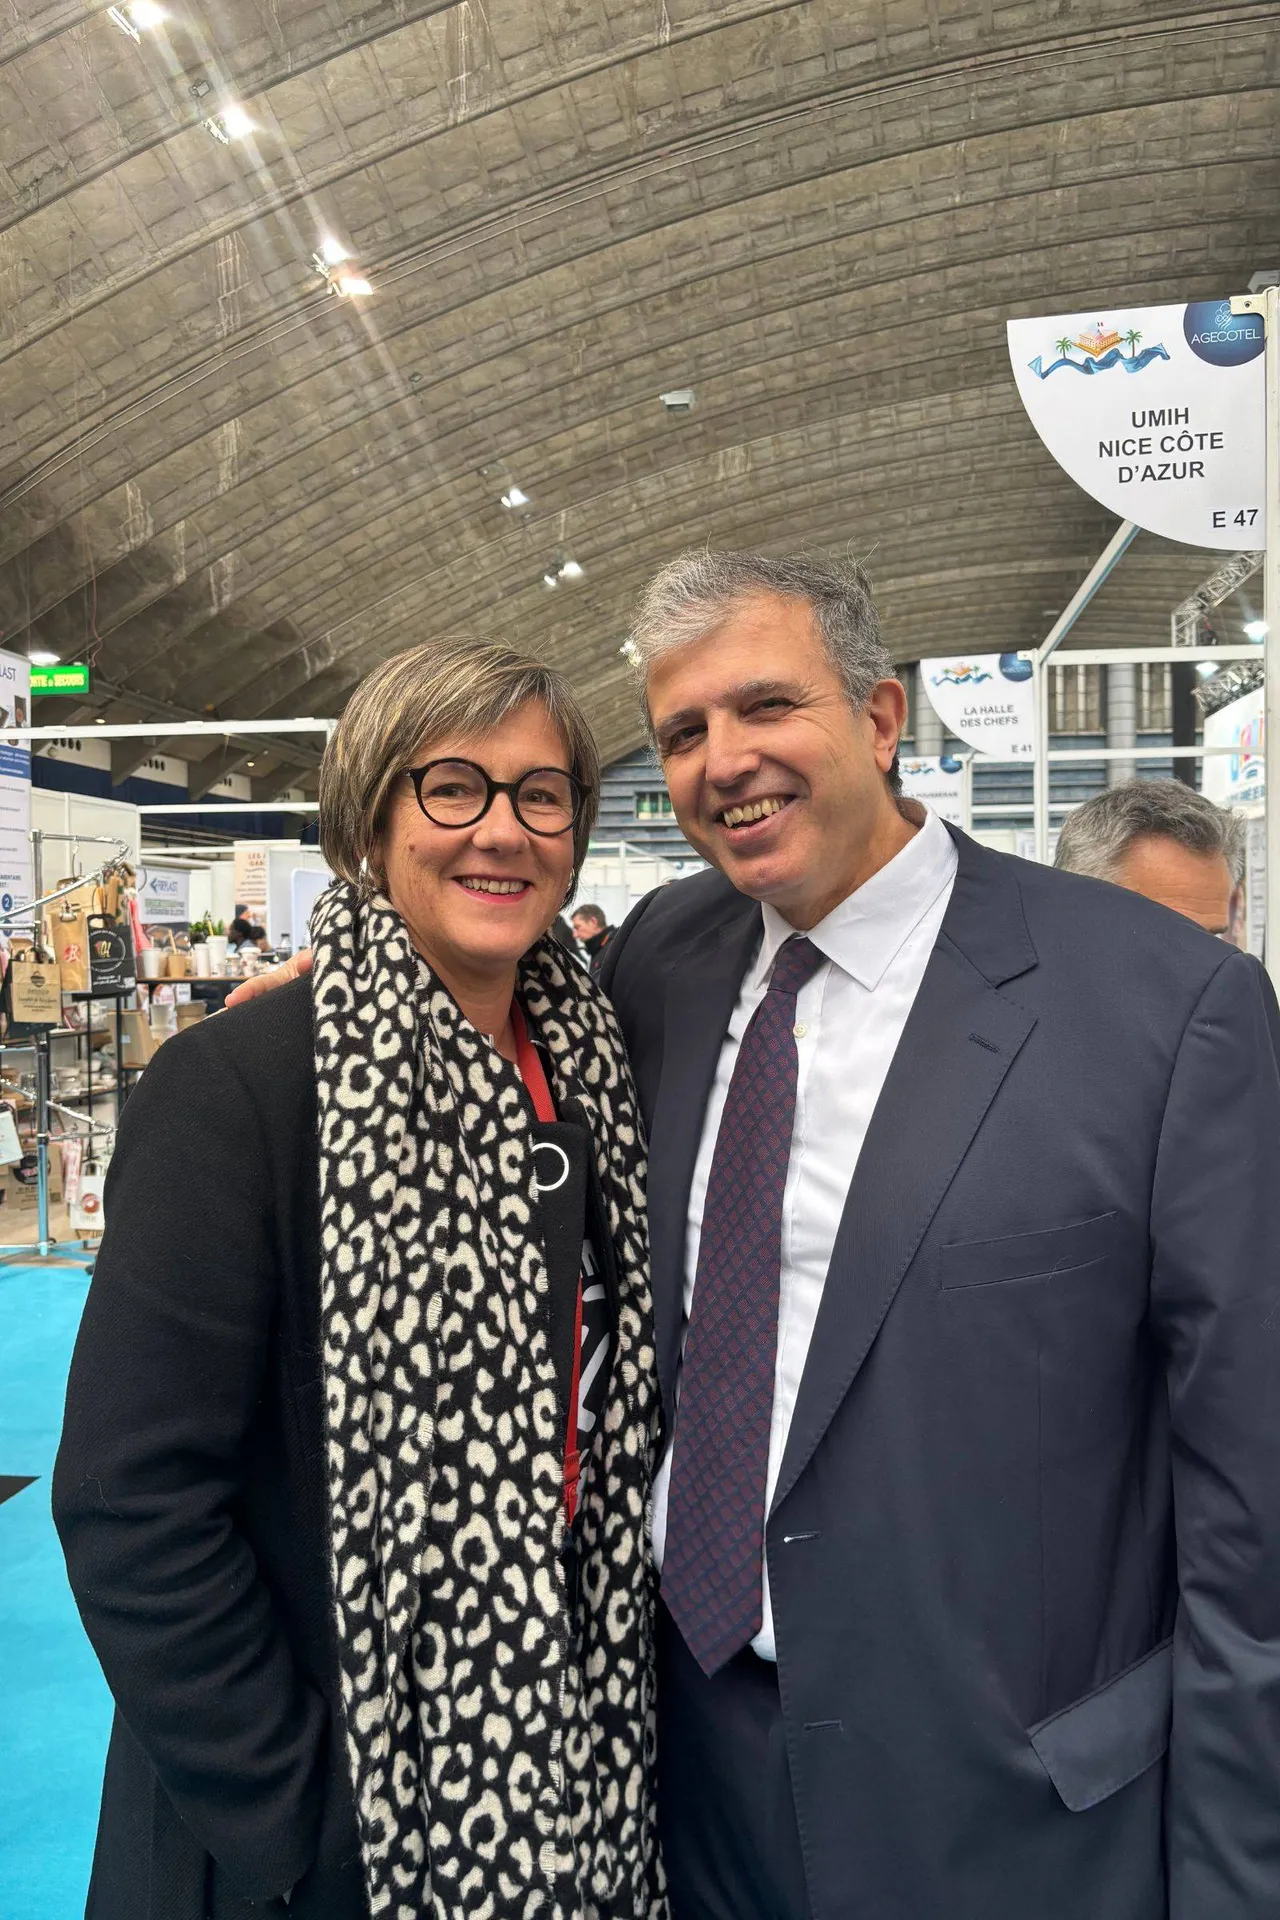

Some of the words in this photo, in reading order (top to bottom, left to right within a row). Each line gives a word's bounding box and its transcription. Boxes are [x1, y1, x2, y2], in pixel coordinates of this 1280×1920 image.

[1191, 328, 1261, 345] AGECOTEL
[1131, 407, 1190, 429] UMIH
[1099, 437, 1152, 458] NICE
[1160, 430, 1224, 453] CÔTE
[1118, 460, 1205, 484] D’AZUR
[1212, 511, 1226, 529] E
[1233, 509, 1259, 528] 47
[964, 706, 978, 716] LA
[980, 704, 1014, 714] HALLE
[960, 718, 981, 729] DES
[984, 715, 1018, 727] CHEFS
[1011, 745, 1018, 753] E
[1020, 744, 1032, 752] 41
[4, 897, 10, 908] 2
